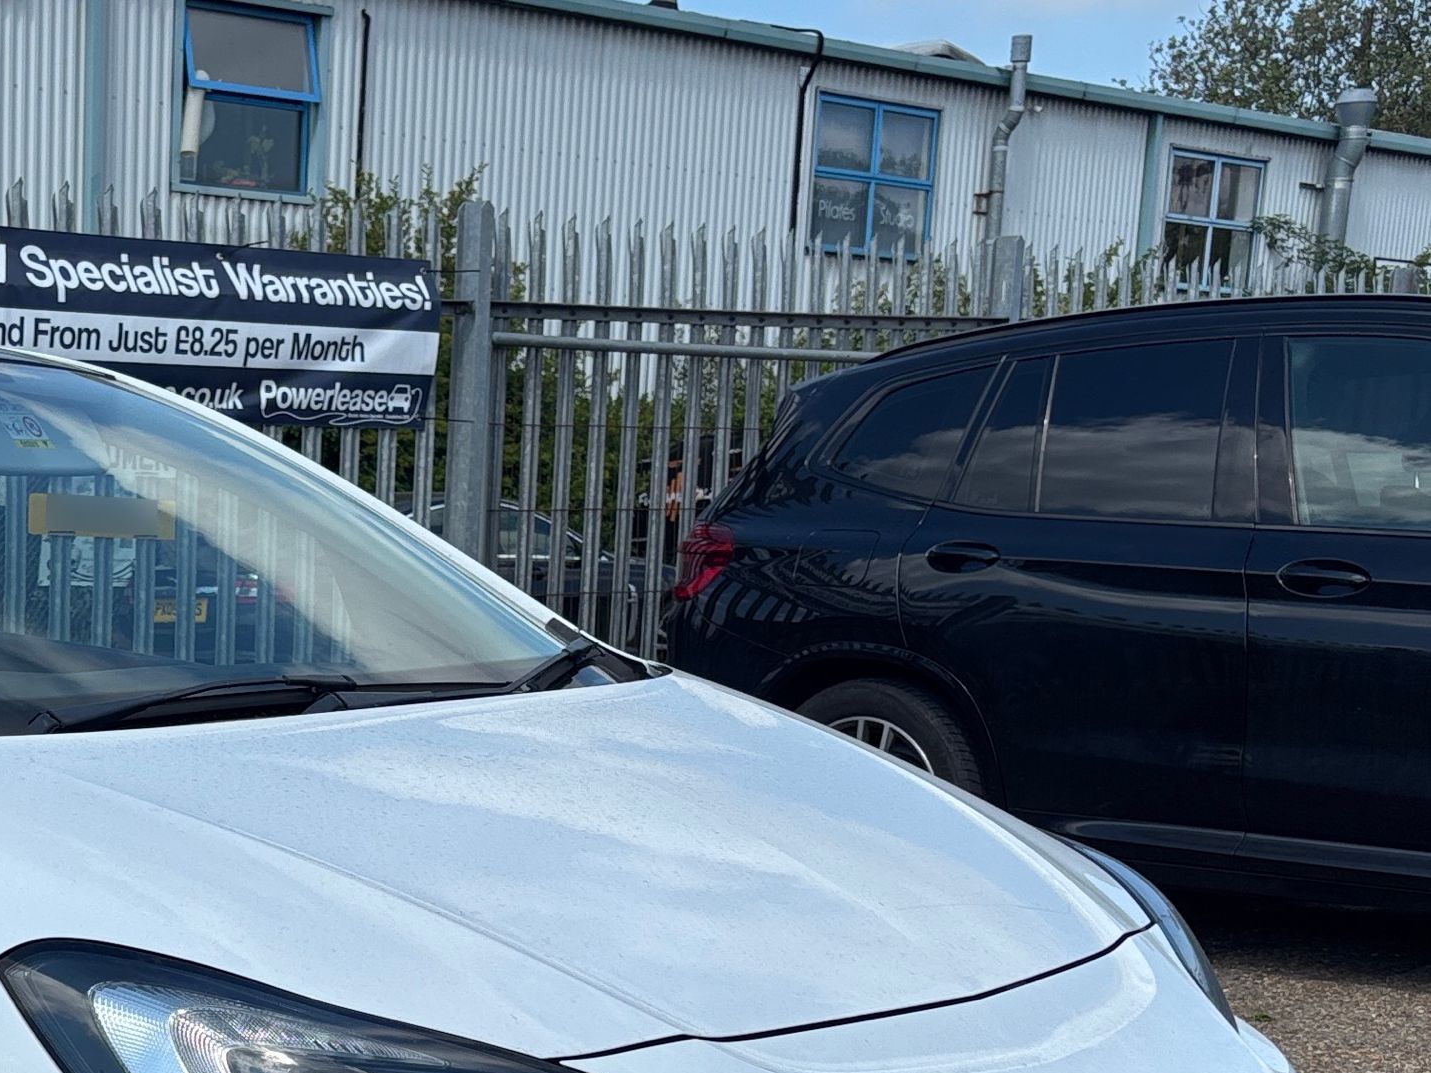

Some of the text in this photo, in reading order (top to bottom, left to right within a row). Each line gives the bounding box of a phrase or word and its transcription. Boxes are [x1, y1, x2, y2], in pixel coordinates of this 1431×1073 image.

[20, 245, 221, 303] Specialist
[220, 260, 432, 312] Warranties!
[33, 318, 101, 352] From
[108, 322, 169, 356] Just
[175, 325, 239, 359] £8.25
[244, 337, 285, 368] per
[290, 332, 366, 363] Month
[259, 379, 388, 412] Powerlease
